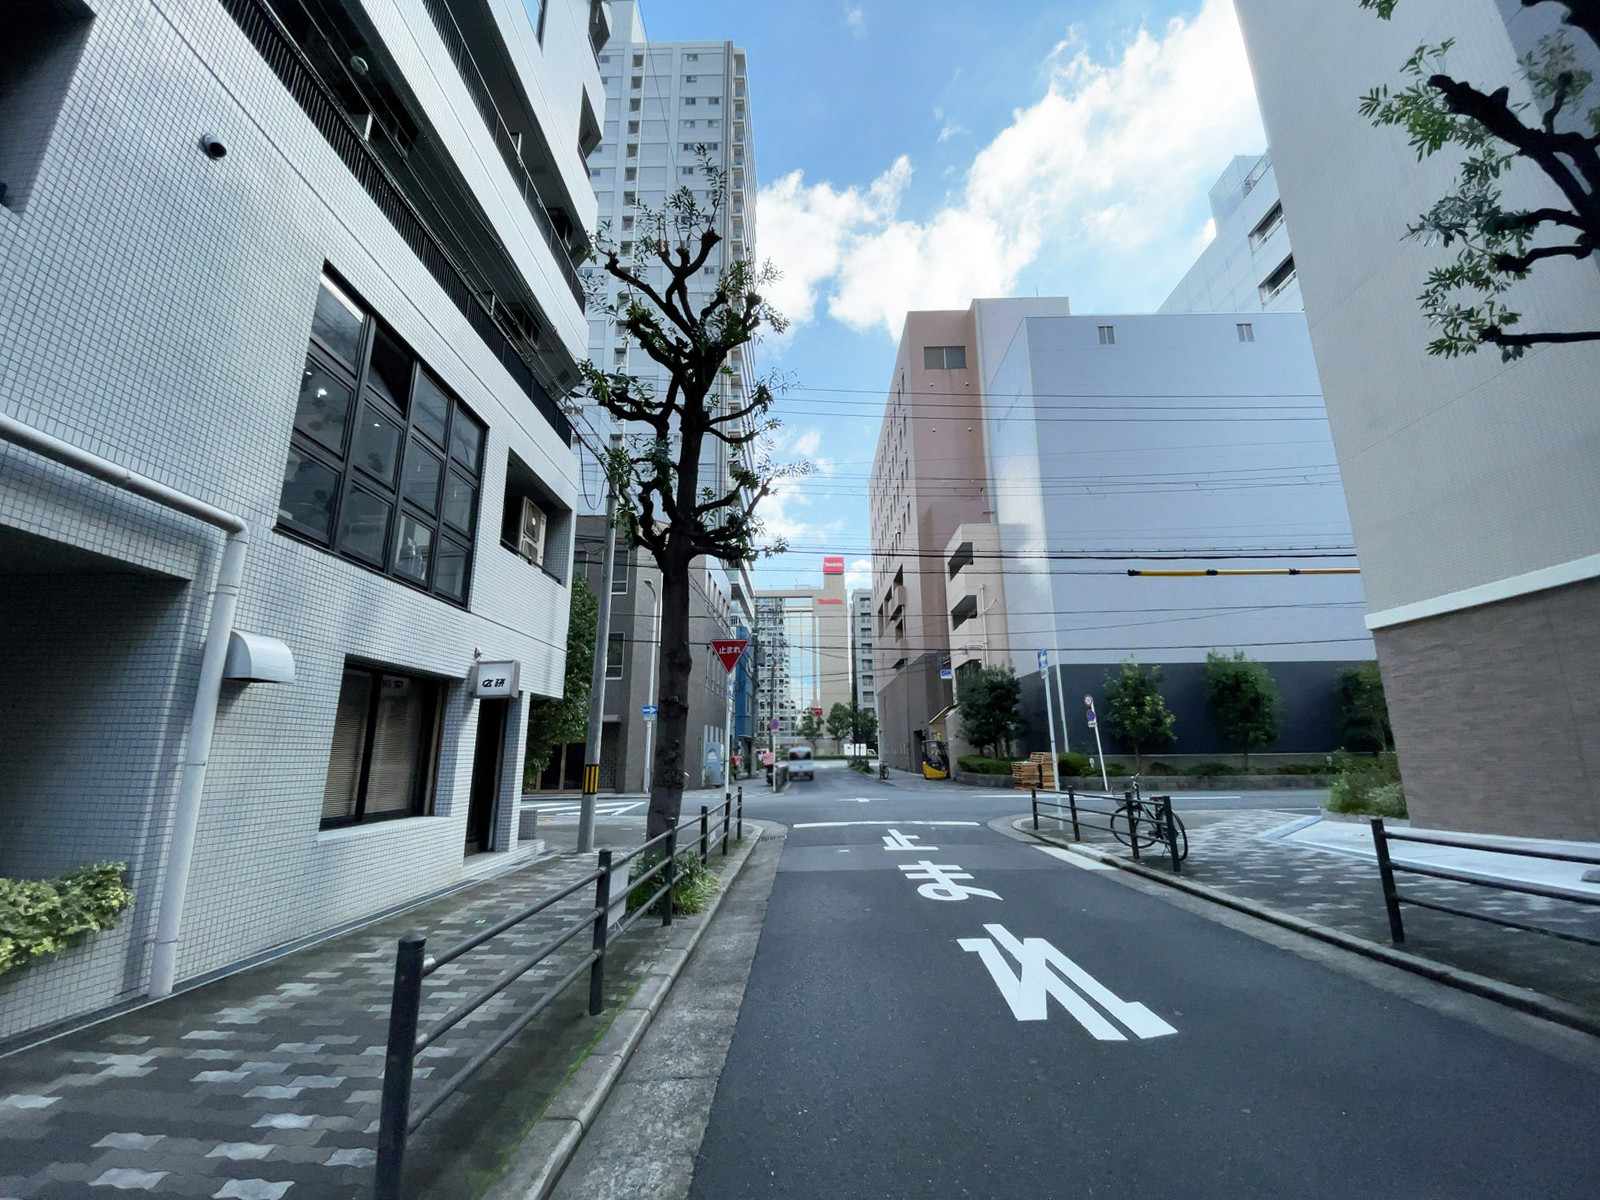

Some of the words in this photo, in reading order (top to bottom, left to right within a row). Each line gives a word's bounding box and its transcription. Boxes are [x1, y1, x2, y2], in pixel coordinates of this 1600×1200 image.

[719, 646, 741, 654] 止まれ
[882, 829, 1178, 1041] 止まれ
